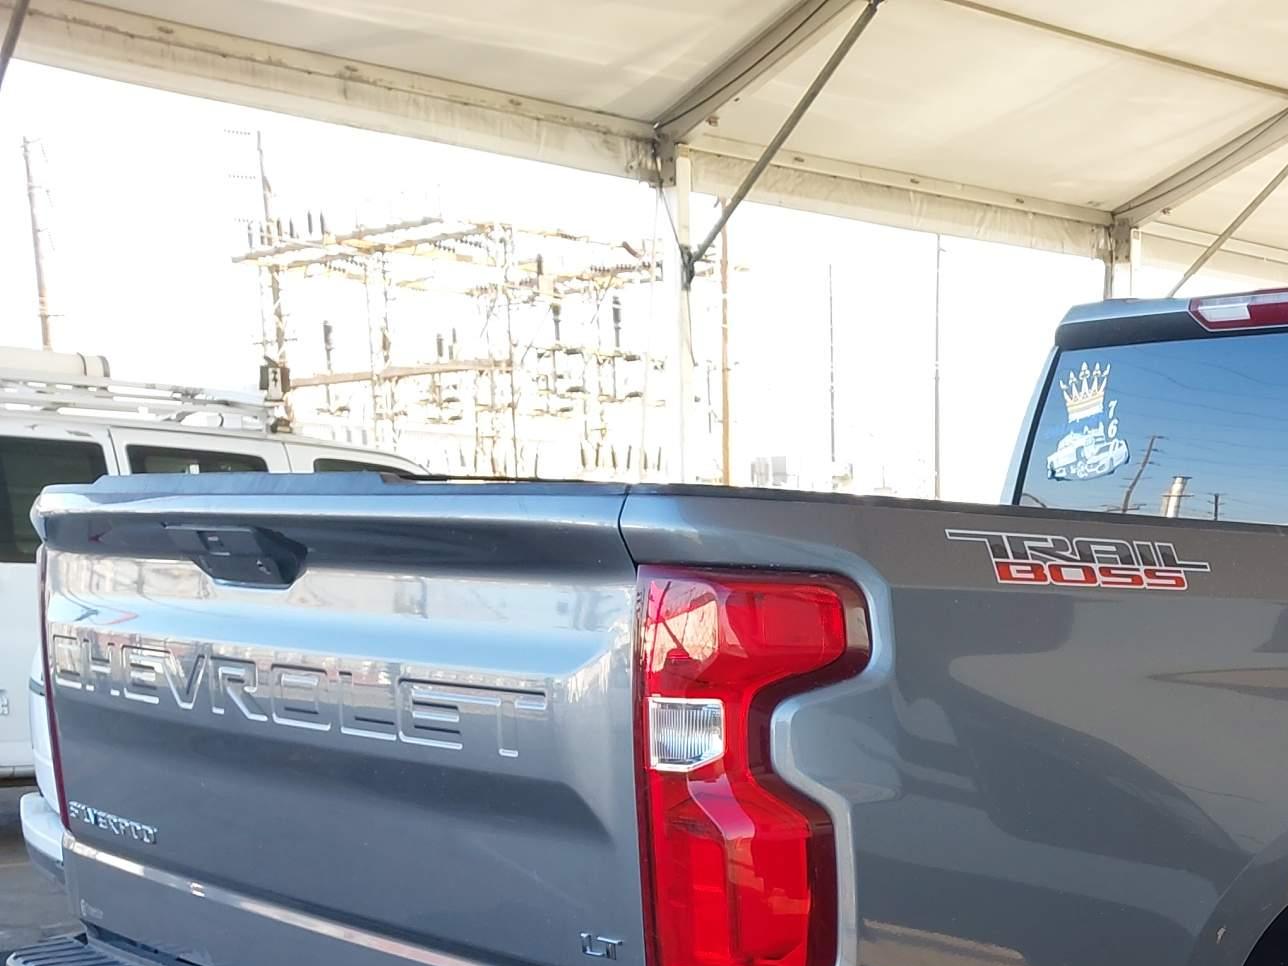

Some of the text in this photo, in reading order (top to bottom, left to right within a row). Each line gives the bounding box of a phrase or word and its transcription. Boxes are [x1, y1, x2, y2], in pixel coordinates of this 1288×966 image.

[945, 528, 1211, 571] TRAIL
[993, 559, 1188, 590] BOSS
[52, 633, 548, 757] CHEVROLET
[580, 932, 623, 960] LT
